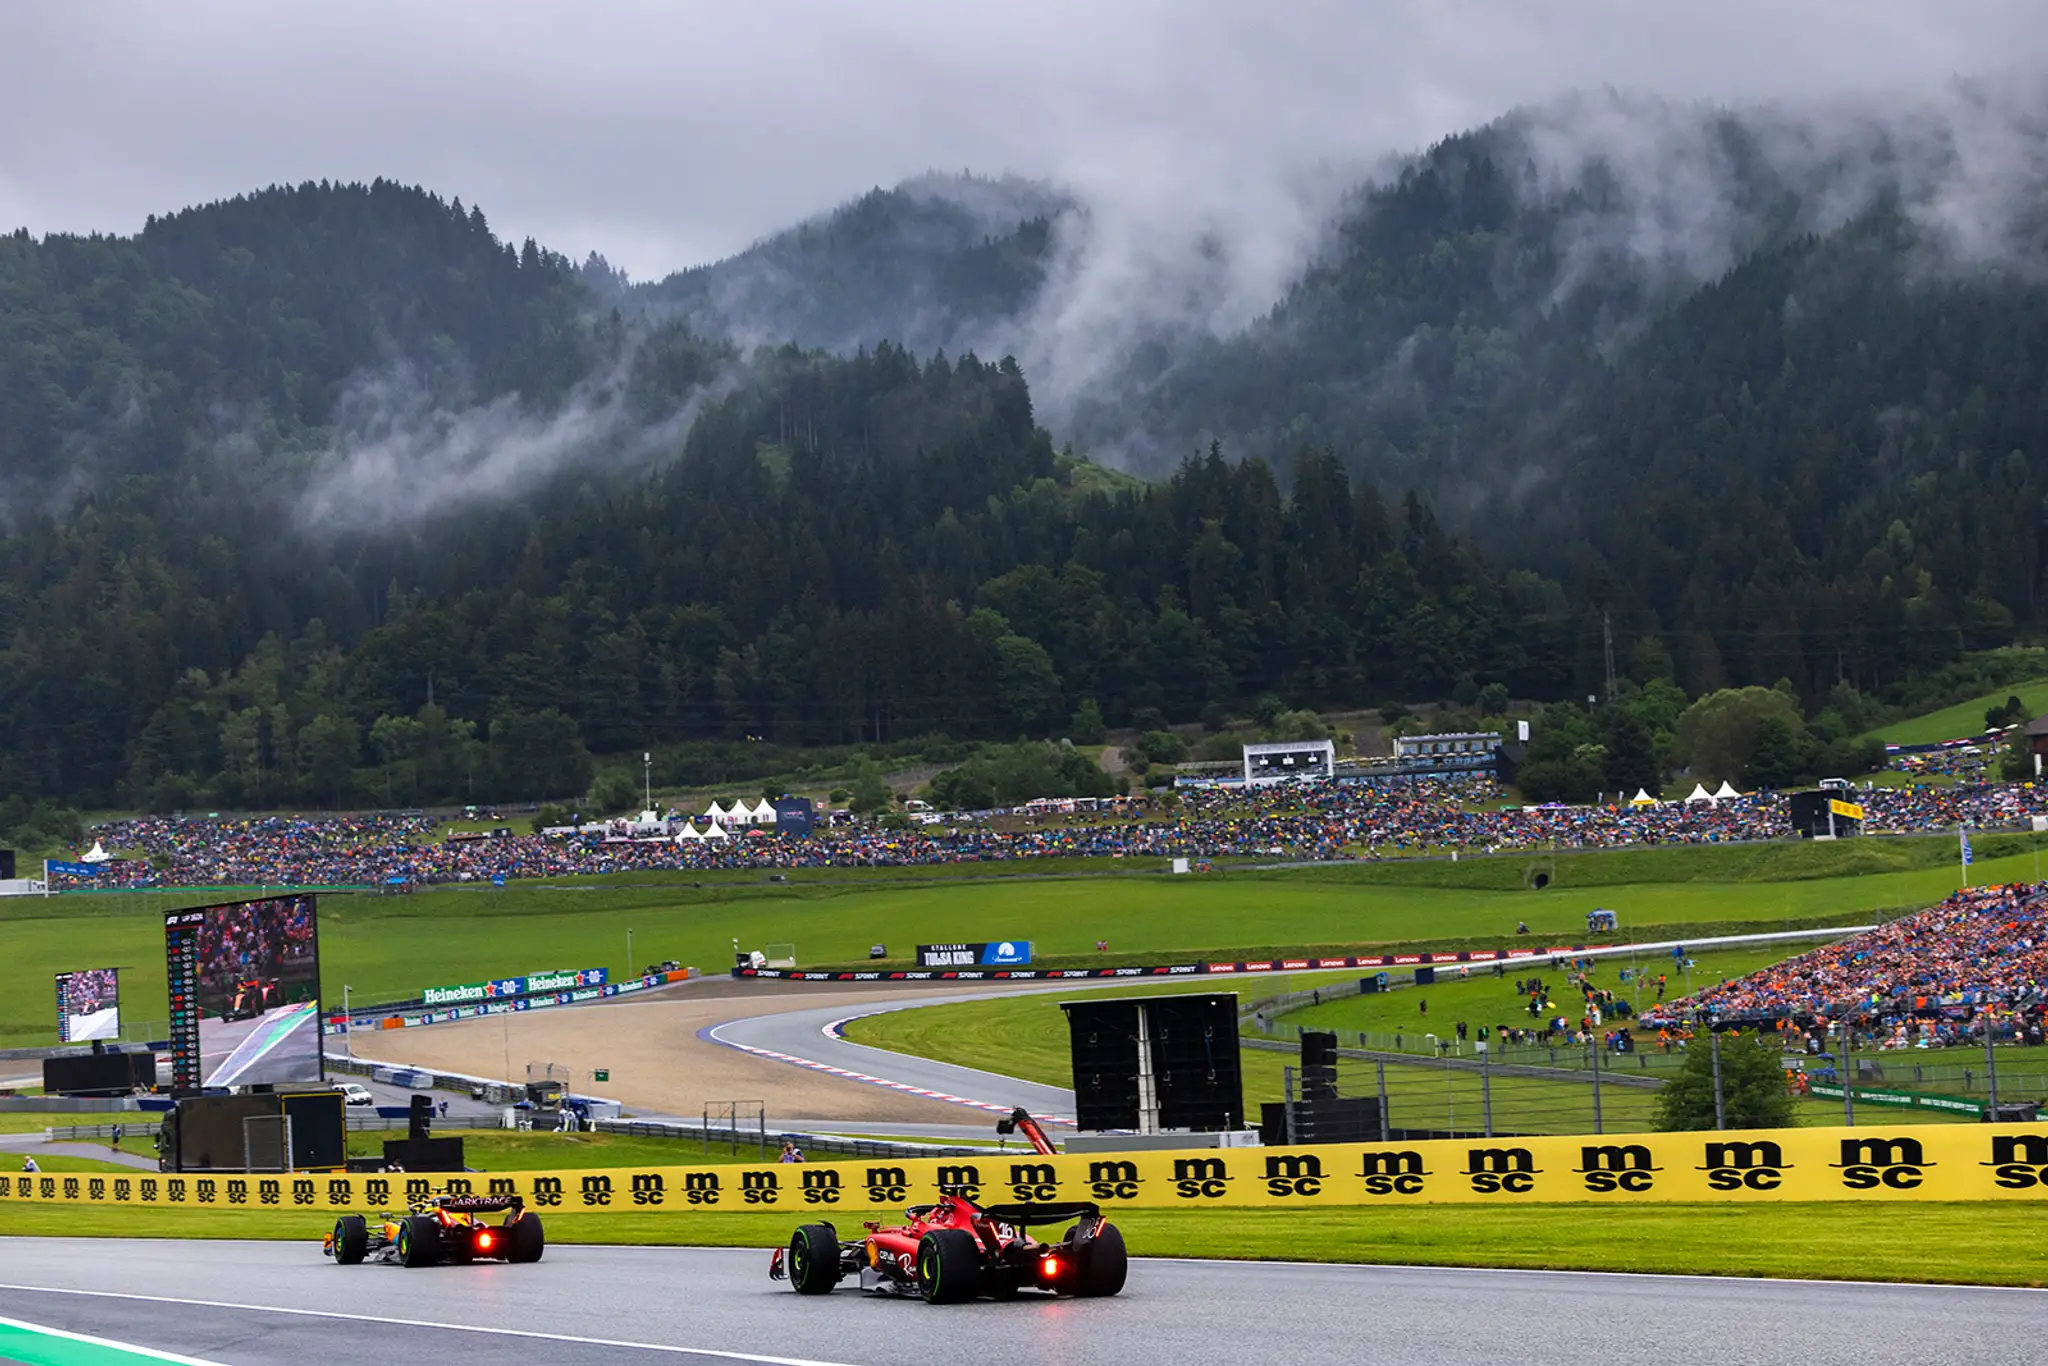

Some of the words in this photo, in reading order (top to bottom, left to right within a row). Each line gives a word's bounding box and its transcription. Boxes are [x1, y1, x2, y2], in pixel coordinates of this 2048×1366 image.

[953, 951, 974, 965] KING
[1433, 954, 1457, 962] Lenovo
[1470, 952, 1495, 960] Lenovo
[1283, 961, 1307, 969] Lenovo
[1320, 959, 1345, 967] Lenovo
[1357, 957, 1382, 965] Lenovo
[1210, 964, 1234, 972] Lenovo
[528, 972, 574, 992] Heineken
[424, 986, 483, 1003] Heineken
[450, 1196, 512, 1206] DARKTRACE
[999, 1222, 1014, 1239] 16
